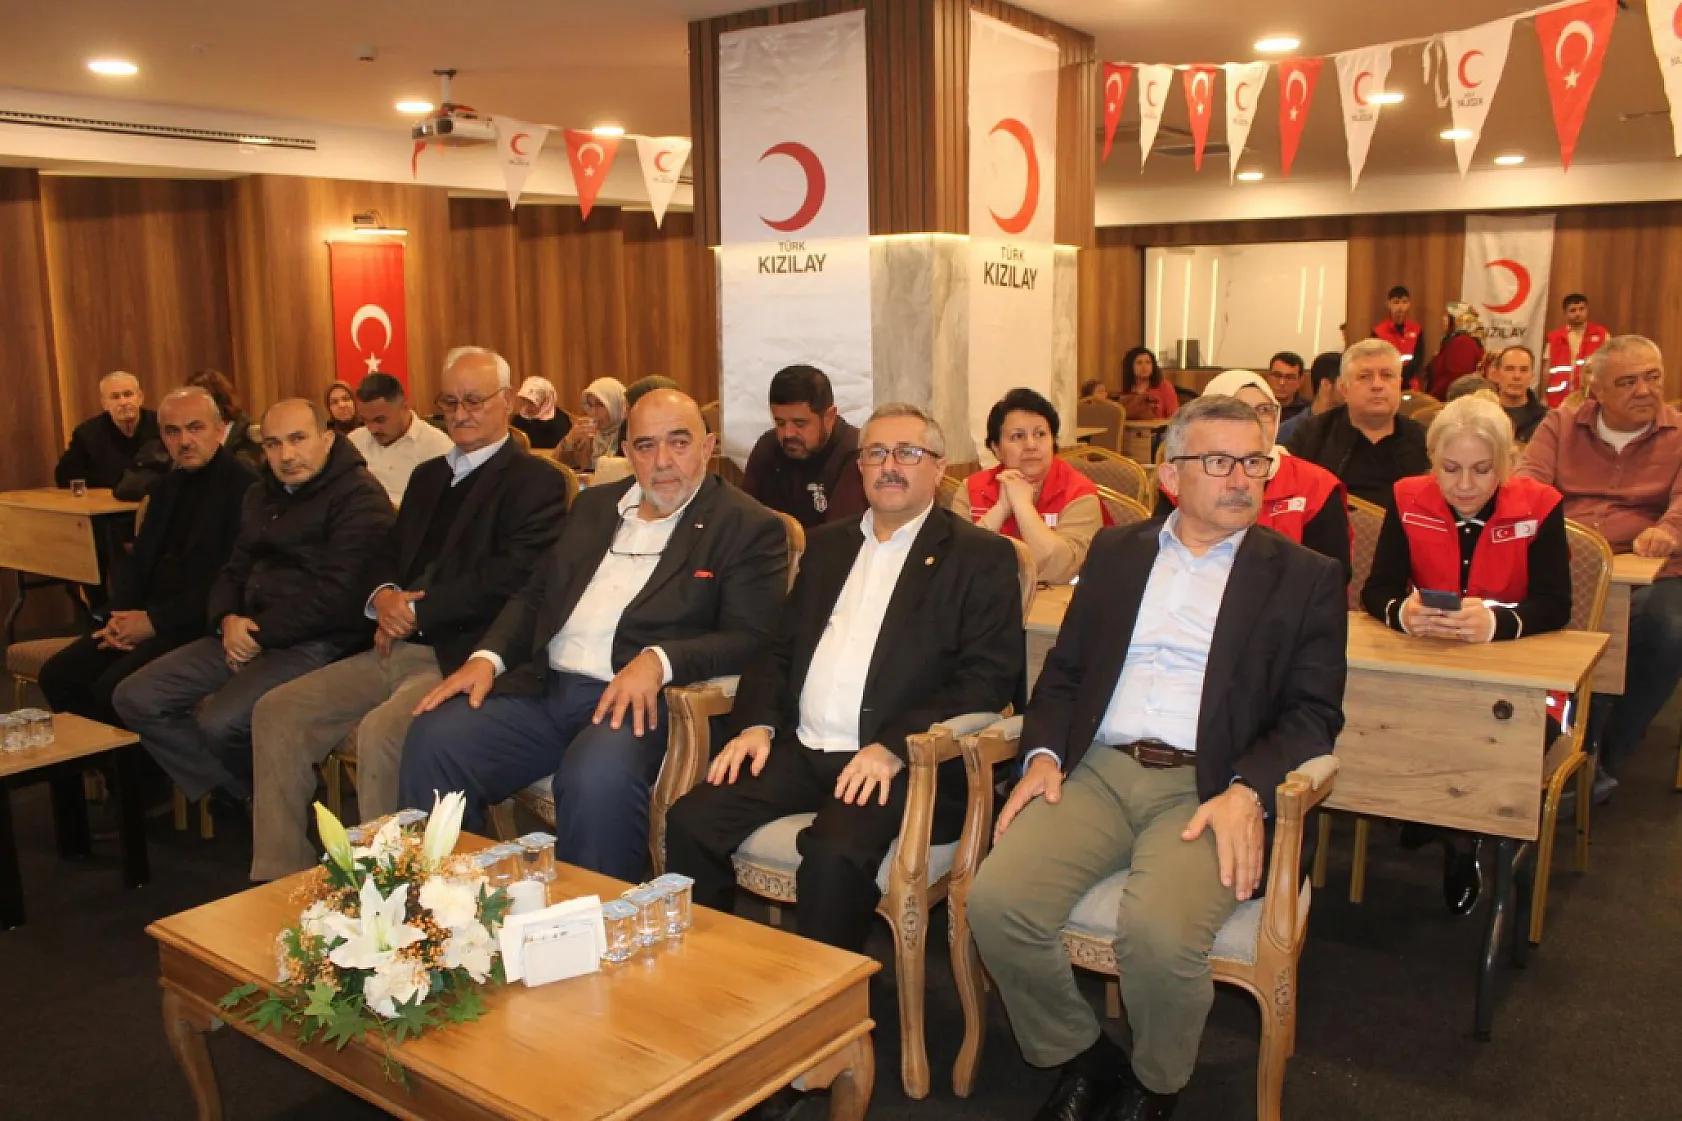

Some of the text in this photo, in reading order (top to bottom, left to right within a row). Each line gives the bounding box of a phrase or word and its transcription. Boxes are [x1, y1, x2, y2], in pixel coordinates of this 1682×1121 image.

[778, 240, 806, 252] TÜRK
[1001, 244, 1024, 261] TÜRK
[757, 253, 827, 274] KIZILAY
[983, 261, 1038, 290] KIZILAY
